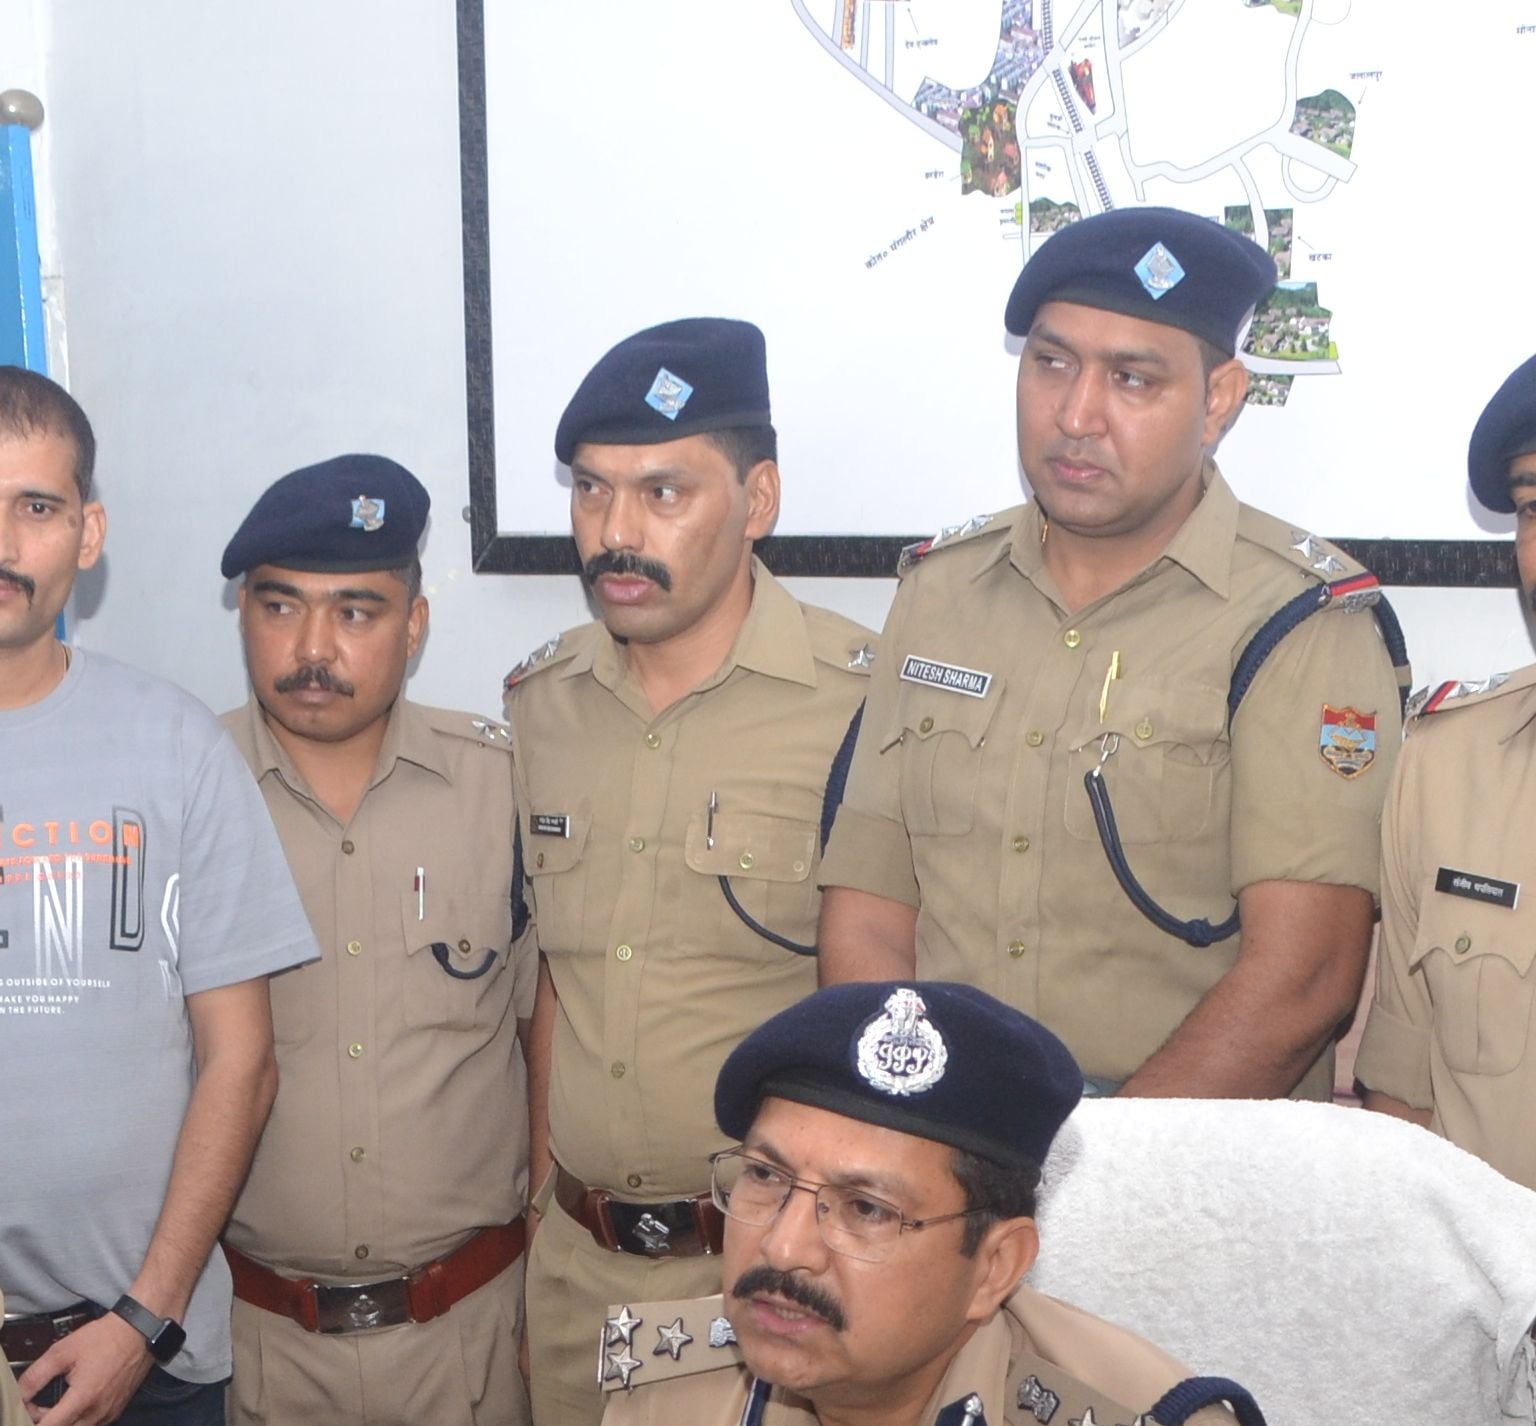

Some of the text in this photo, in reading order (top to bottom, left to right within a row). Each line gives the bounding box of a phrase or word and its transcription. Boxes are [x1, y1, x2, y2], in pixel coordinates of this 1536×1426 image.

[907, 660, 983, 692] NITESH SHARMA
[6, 978, 48, 986] OUTSIDE
[50, 978, 63, 986] OF
[66, 978, 111, 988] YOURSELF
[25, 995, 45, 1003] YOU
[48, 995, 79, 1003] HAPPY
[8, 1006, 24, 1014] THE
